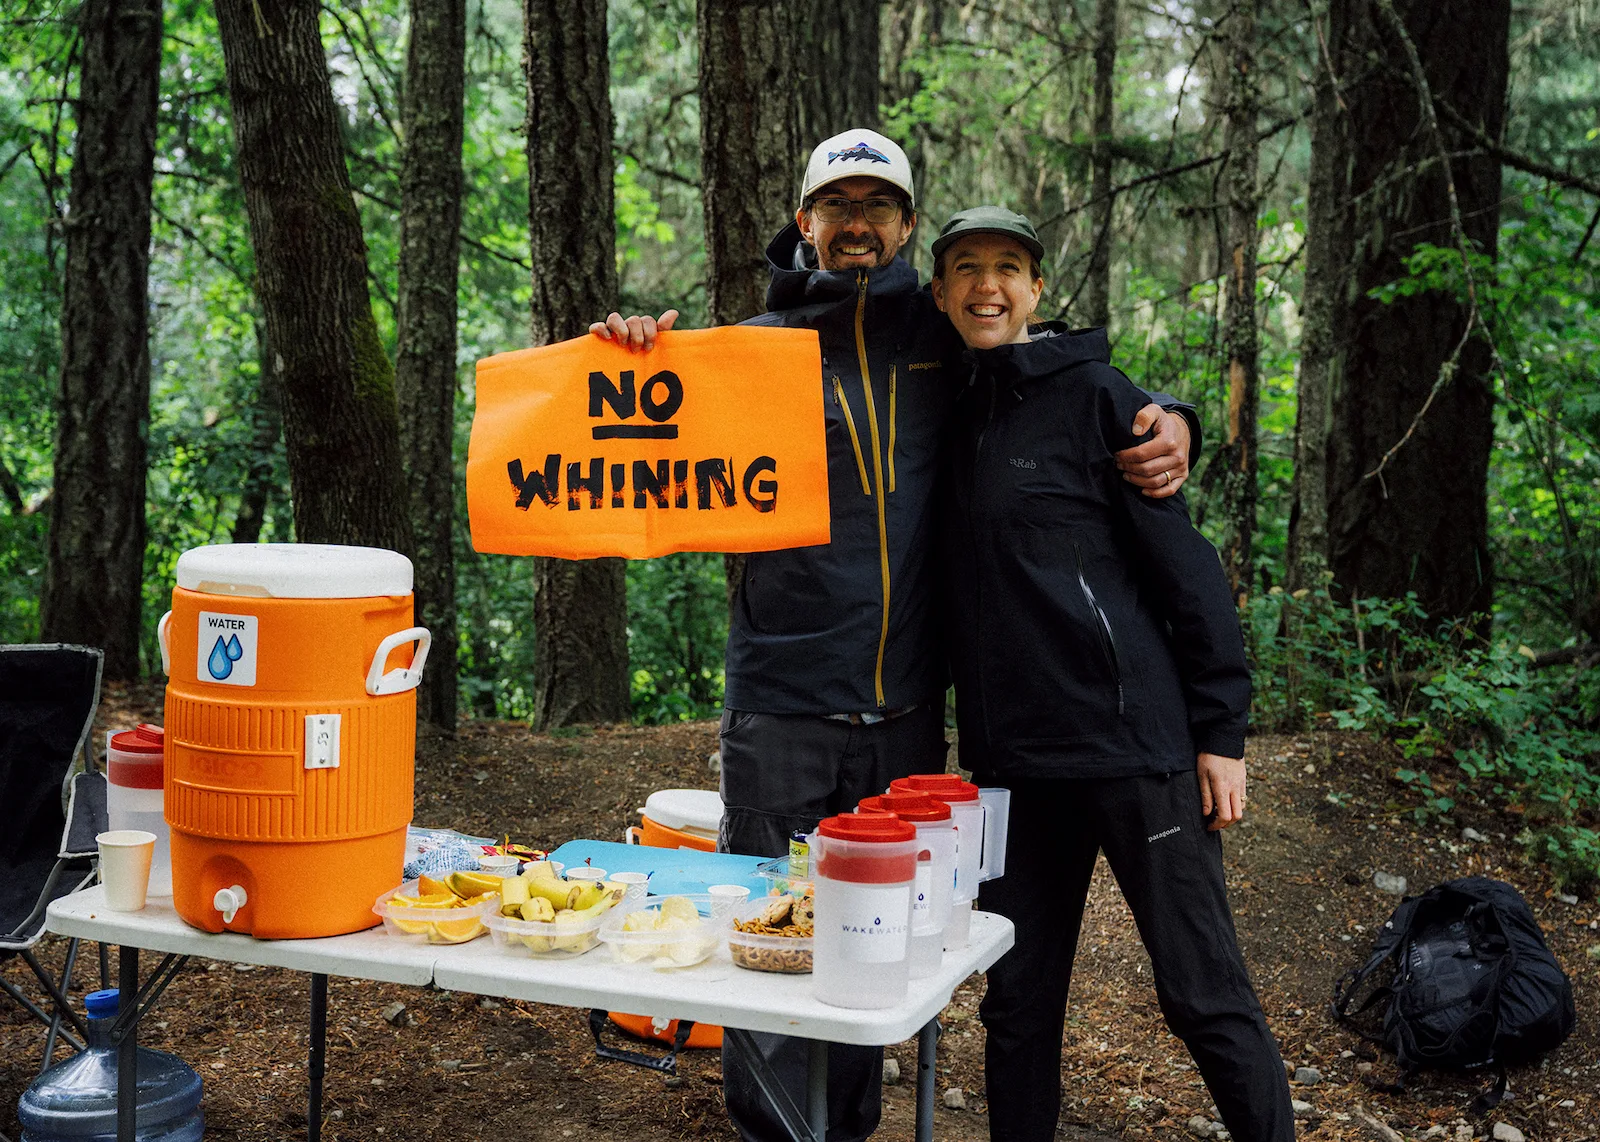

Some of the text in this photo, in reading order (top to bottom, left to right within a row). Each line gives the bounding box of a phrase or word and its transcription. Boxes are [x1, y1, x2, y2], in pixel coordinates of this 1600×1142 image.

[908, 360, 943, 371] patagonia
[588, 370, 683, 422] NO
[1016, 458, 1037, 470] Rab
[507, 453, 778, 513] WHINING
[208, 617, 245, 630] WATER
[1148, 826, 1181, 843] patagonia
